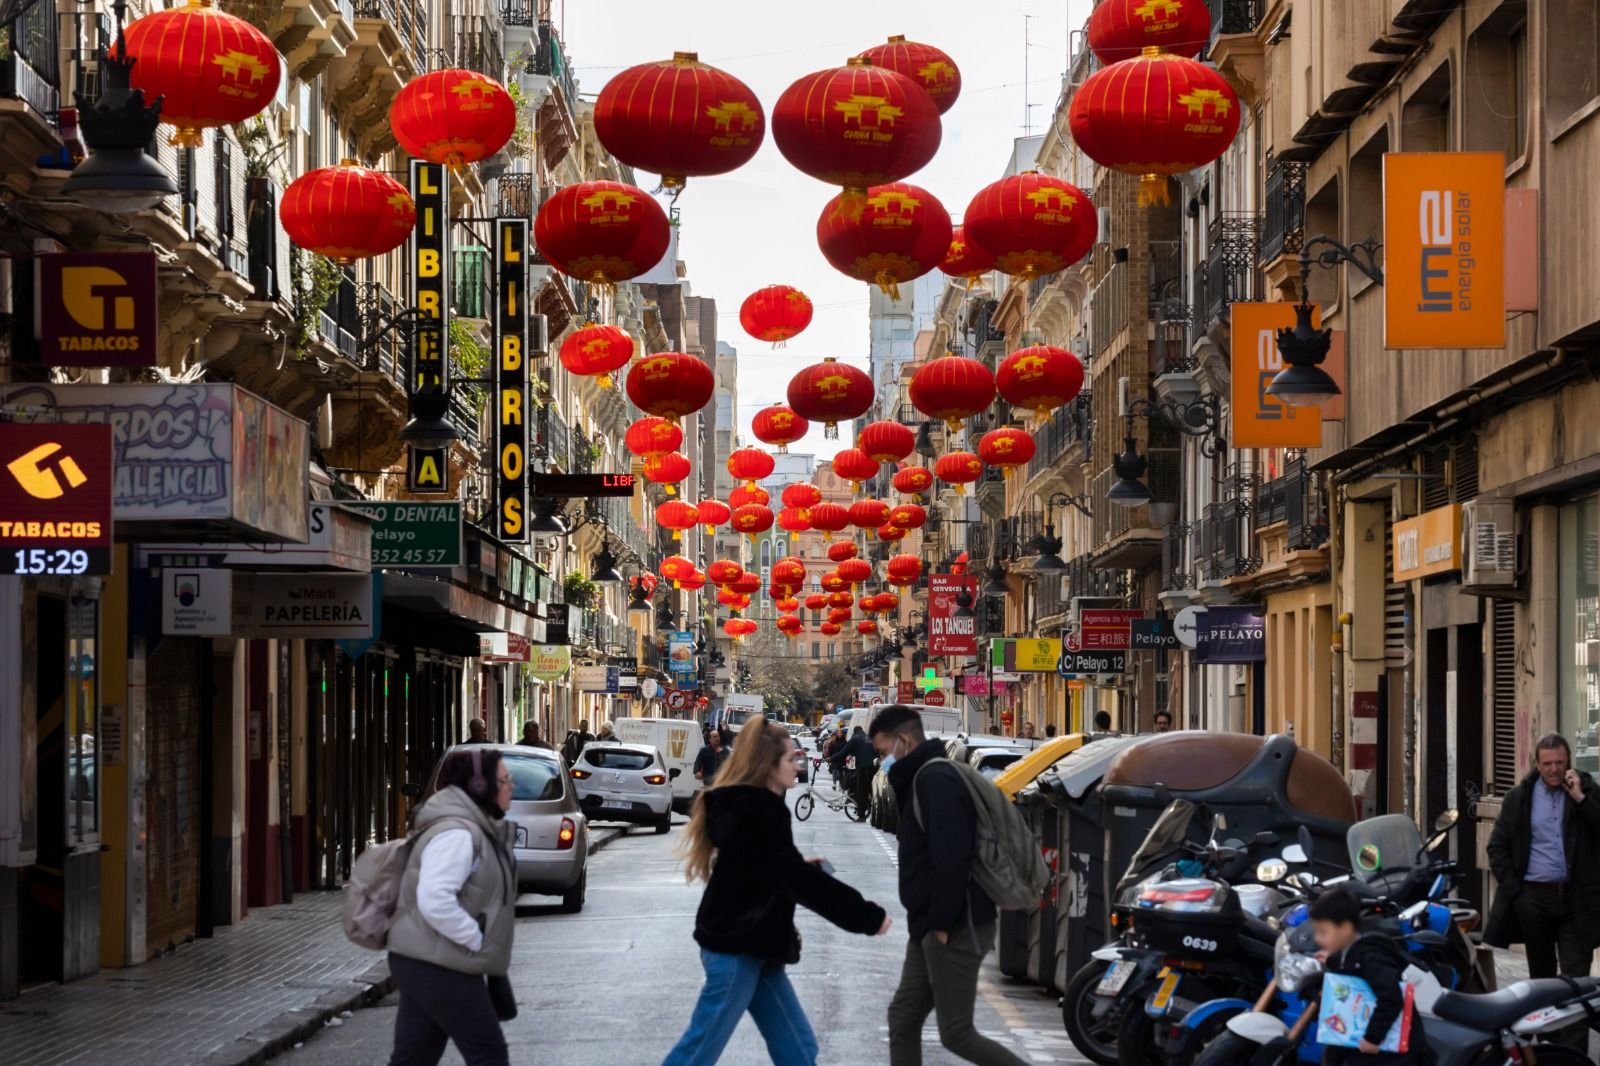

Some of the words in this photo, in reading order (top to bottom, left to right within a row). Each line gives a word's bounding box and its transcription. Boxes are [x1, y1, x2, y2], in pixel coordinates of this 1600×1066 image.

[843, 129, 870, 140] CHINA
[872, 131, 894, 143] TOWN
[873, 217, 894, 226] CHINA
[896, 217, 913, 226] TOWN
[1458, 190, 1473, 237] solar
[418, 166, 441, 485] LIBREA
[58, 336, 139, 352] TABACOS
[502, 225, 524, 536] LIBROS
[114, 465, 218, 498] ALENCIA
[393, 506, 457, 523] DENTAL
[0, 521, 101, 539] TABACOS
[371, 528, 416, 543] elayo
[14, 549, 89, 575] 15:29
[403, 549, 423, 563] 45
[425, 549, 447, 563] 57
[264, 600, 363, 622] PAPELERÍA
[1083, 615, 1111, 624] Agencia
[931, 617, 943, 635] LOS
[944, 617, 974, 636] TANQUES
[1210, 629, 1263, 640] PELAYO
[1135, 633, 1176, 646] Pelayo
[1076, 655, 1108, 672] Pelayo
[1112, 656, 1124, 669] 12
[1182, 935, 1218, 952] 0639
